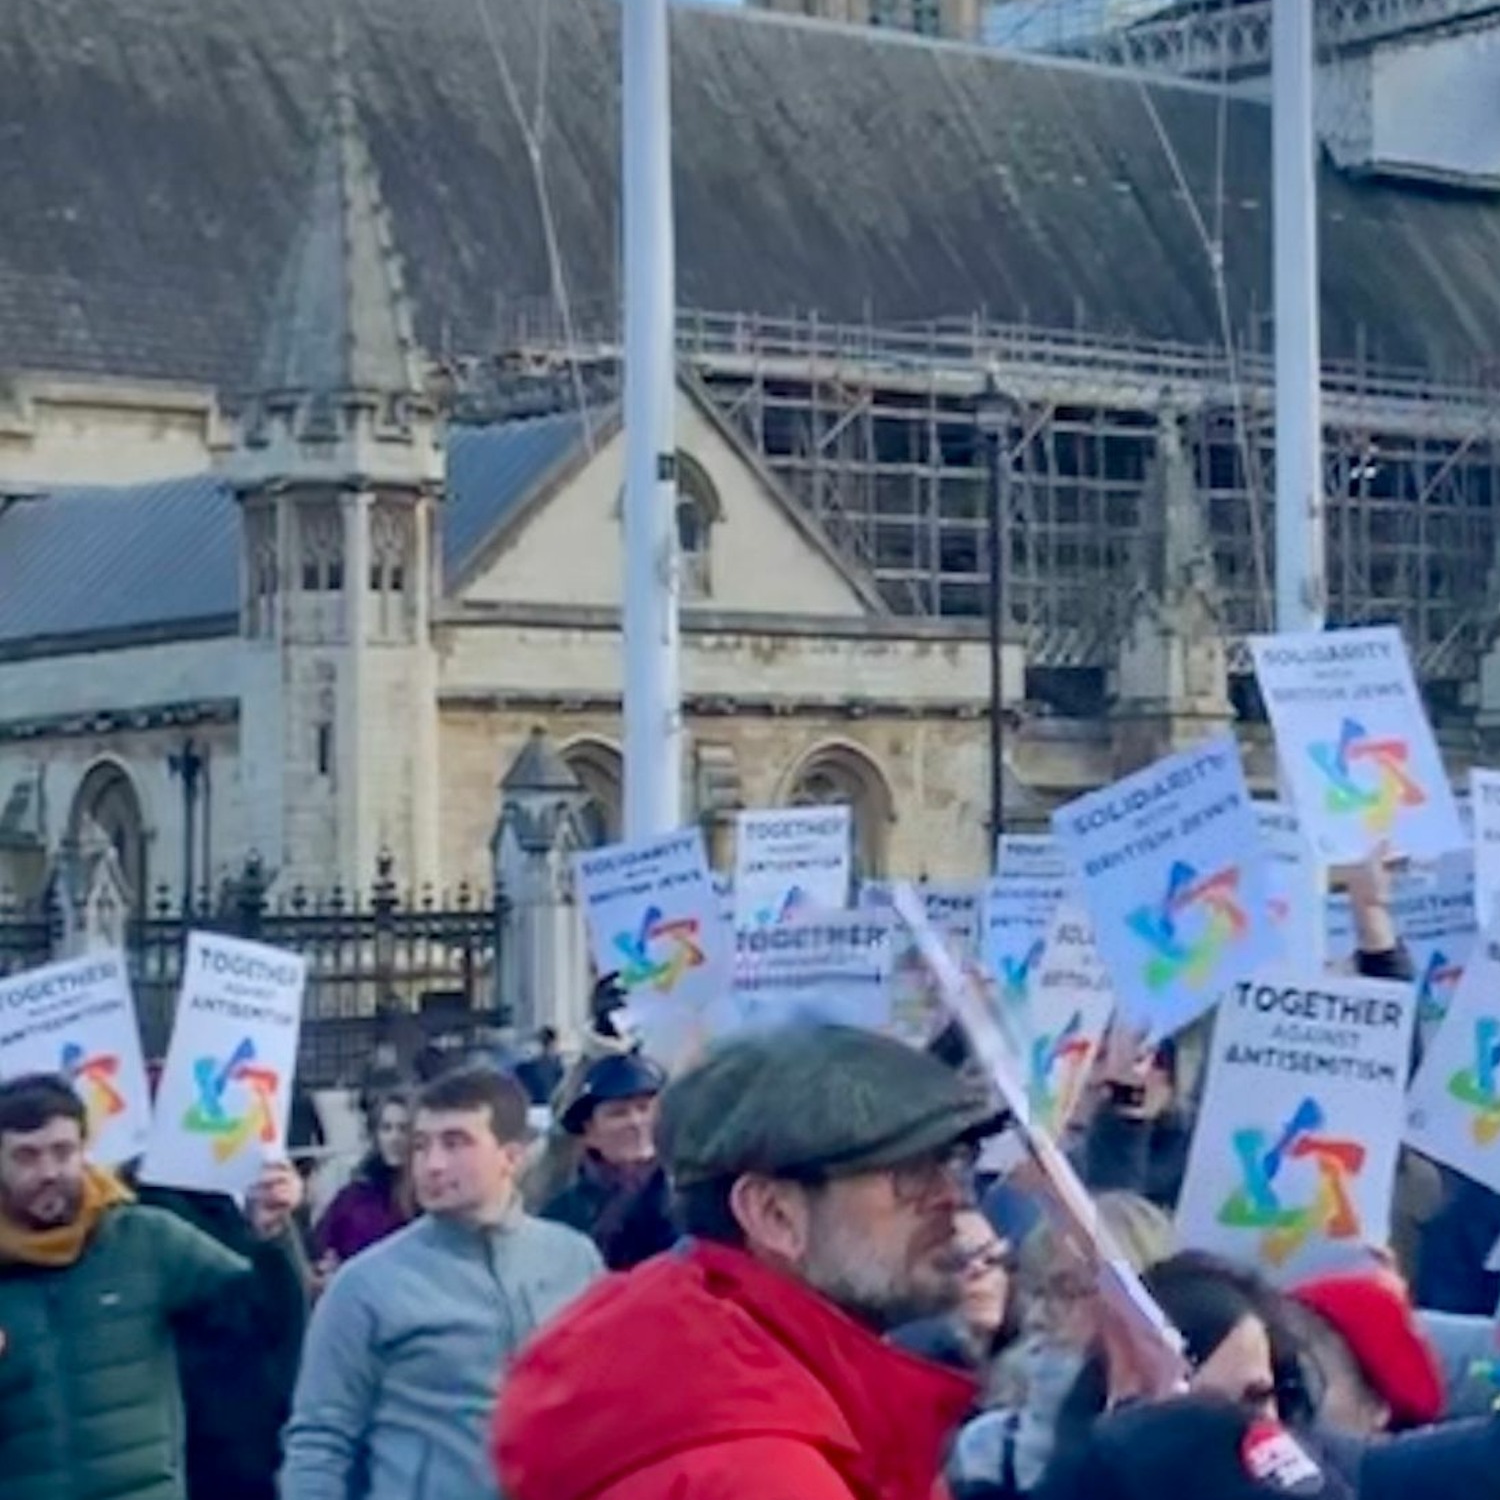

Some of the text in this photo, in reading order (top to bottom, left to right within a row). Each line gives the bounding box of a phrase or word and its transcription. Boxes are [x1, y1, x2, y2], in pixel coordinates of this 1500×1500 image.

[1073, 753, 1230, 836] SOLIDARITY
[1234, 981, 1403, 1030] TOGETHER
[1225, 1044, 1396, 1084] ANTISEMITISM
